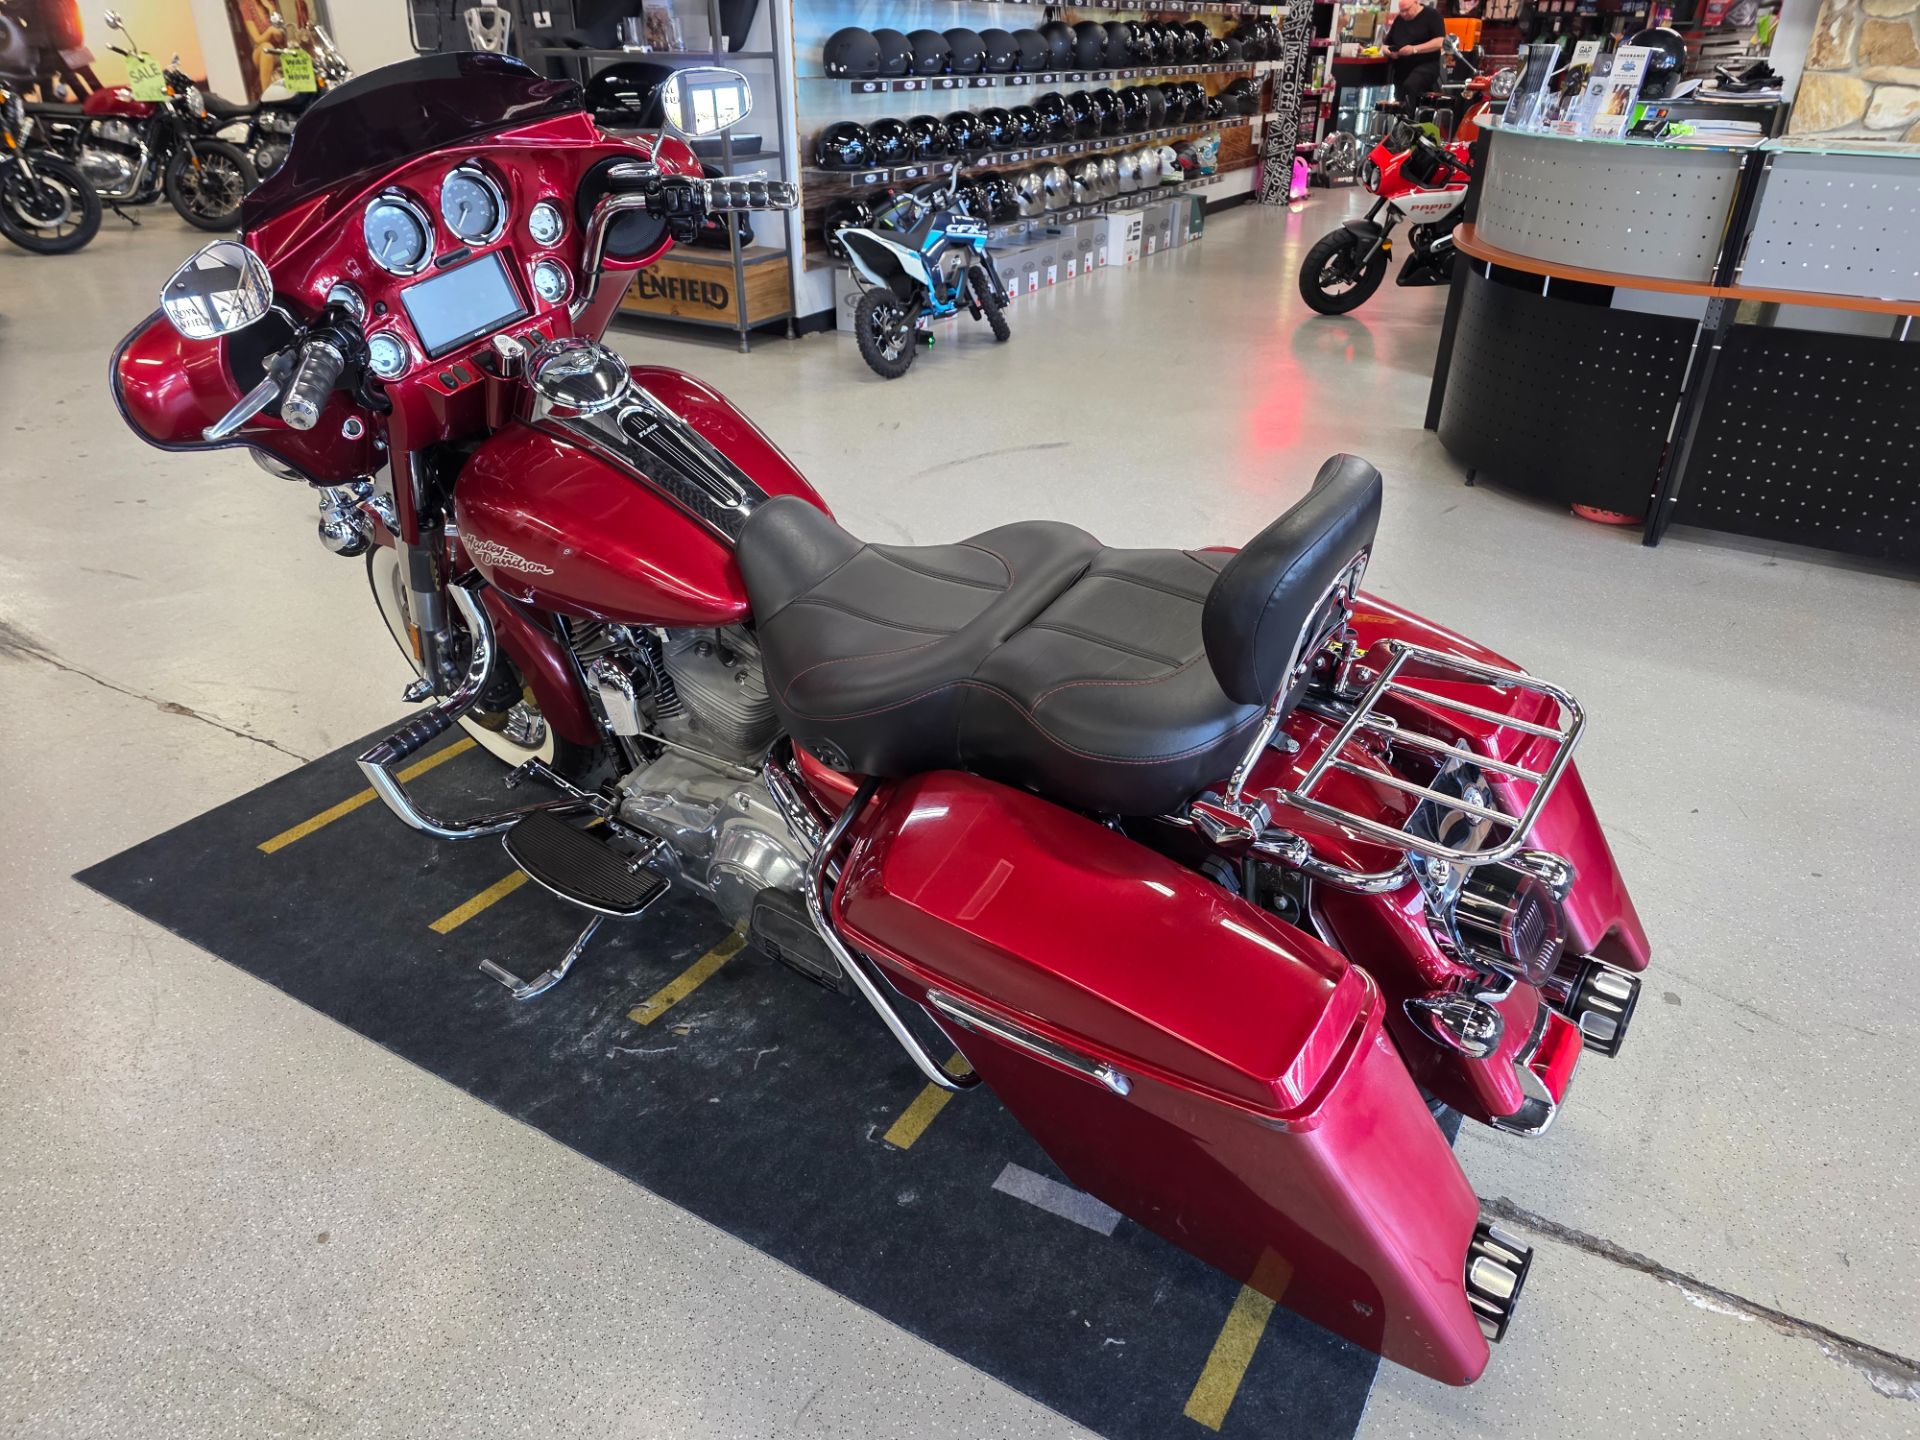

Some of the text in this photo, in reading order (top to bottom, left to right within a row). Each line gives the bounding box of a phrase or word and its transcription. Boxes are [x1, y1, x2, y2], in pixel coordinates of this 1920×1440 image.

[129, 63, 161, 84] SALE
[1282, 44, 1300, 110] Muc-Off
[636, 264, 729, 311] ENFIELD
[480, 551, 555, 576] Davidson
